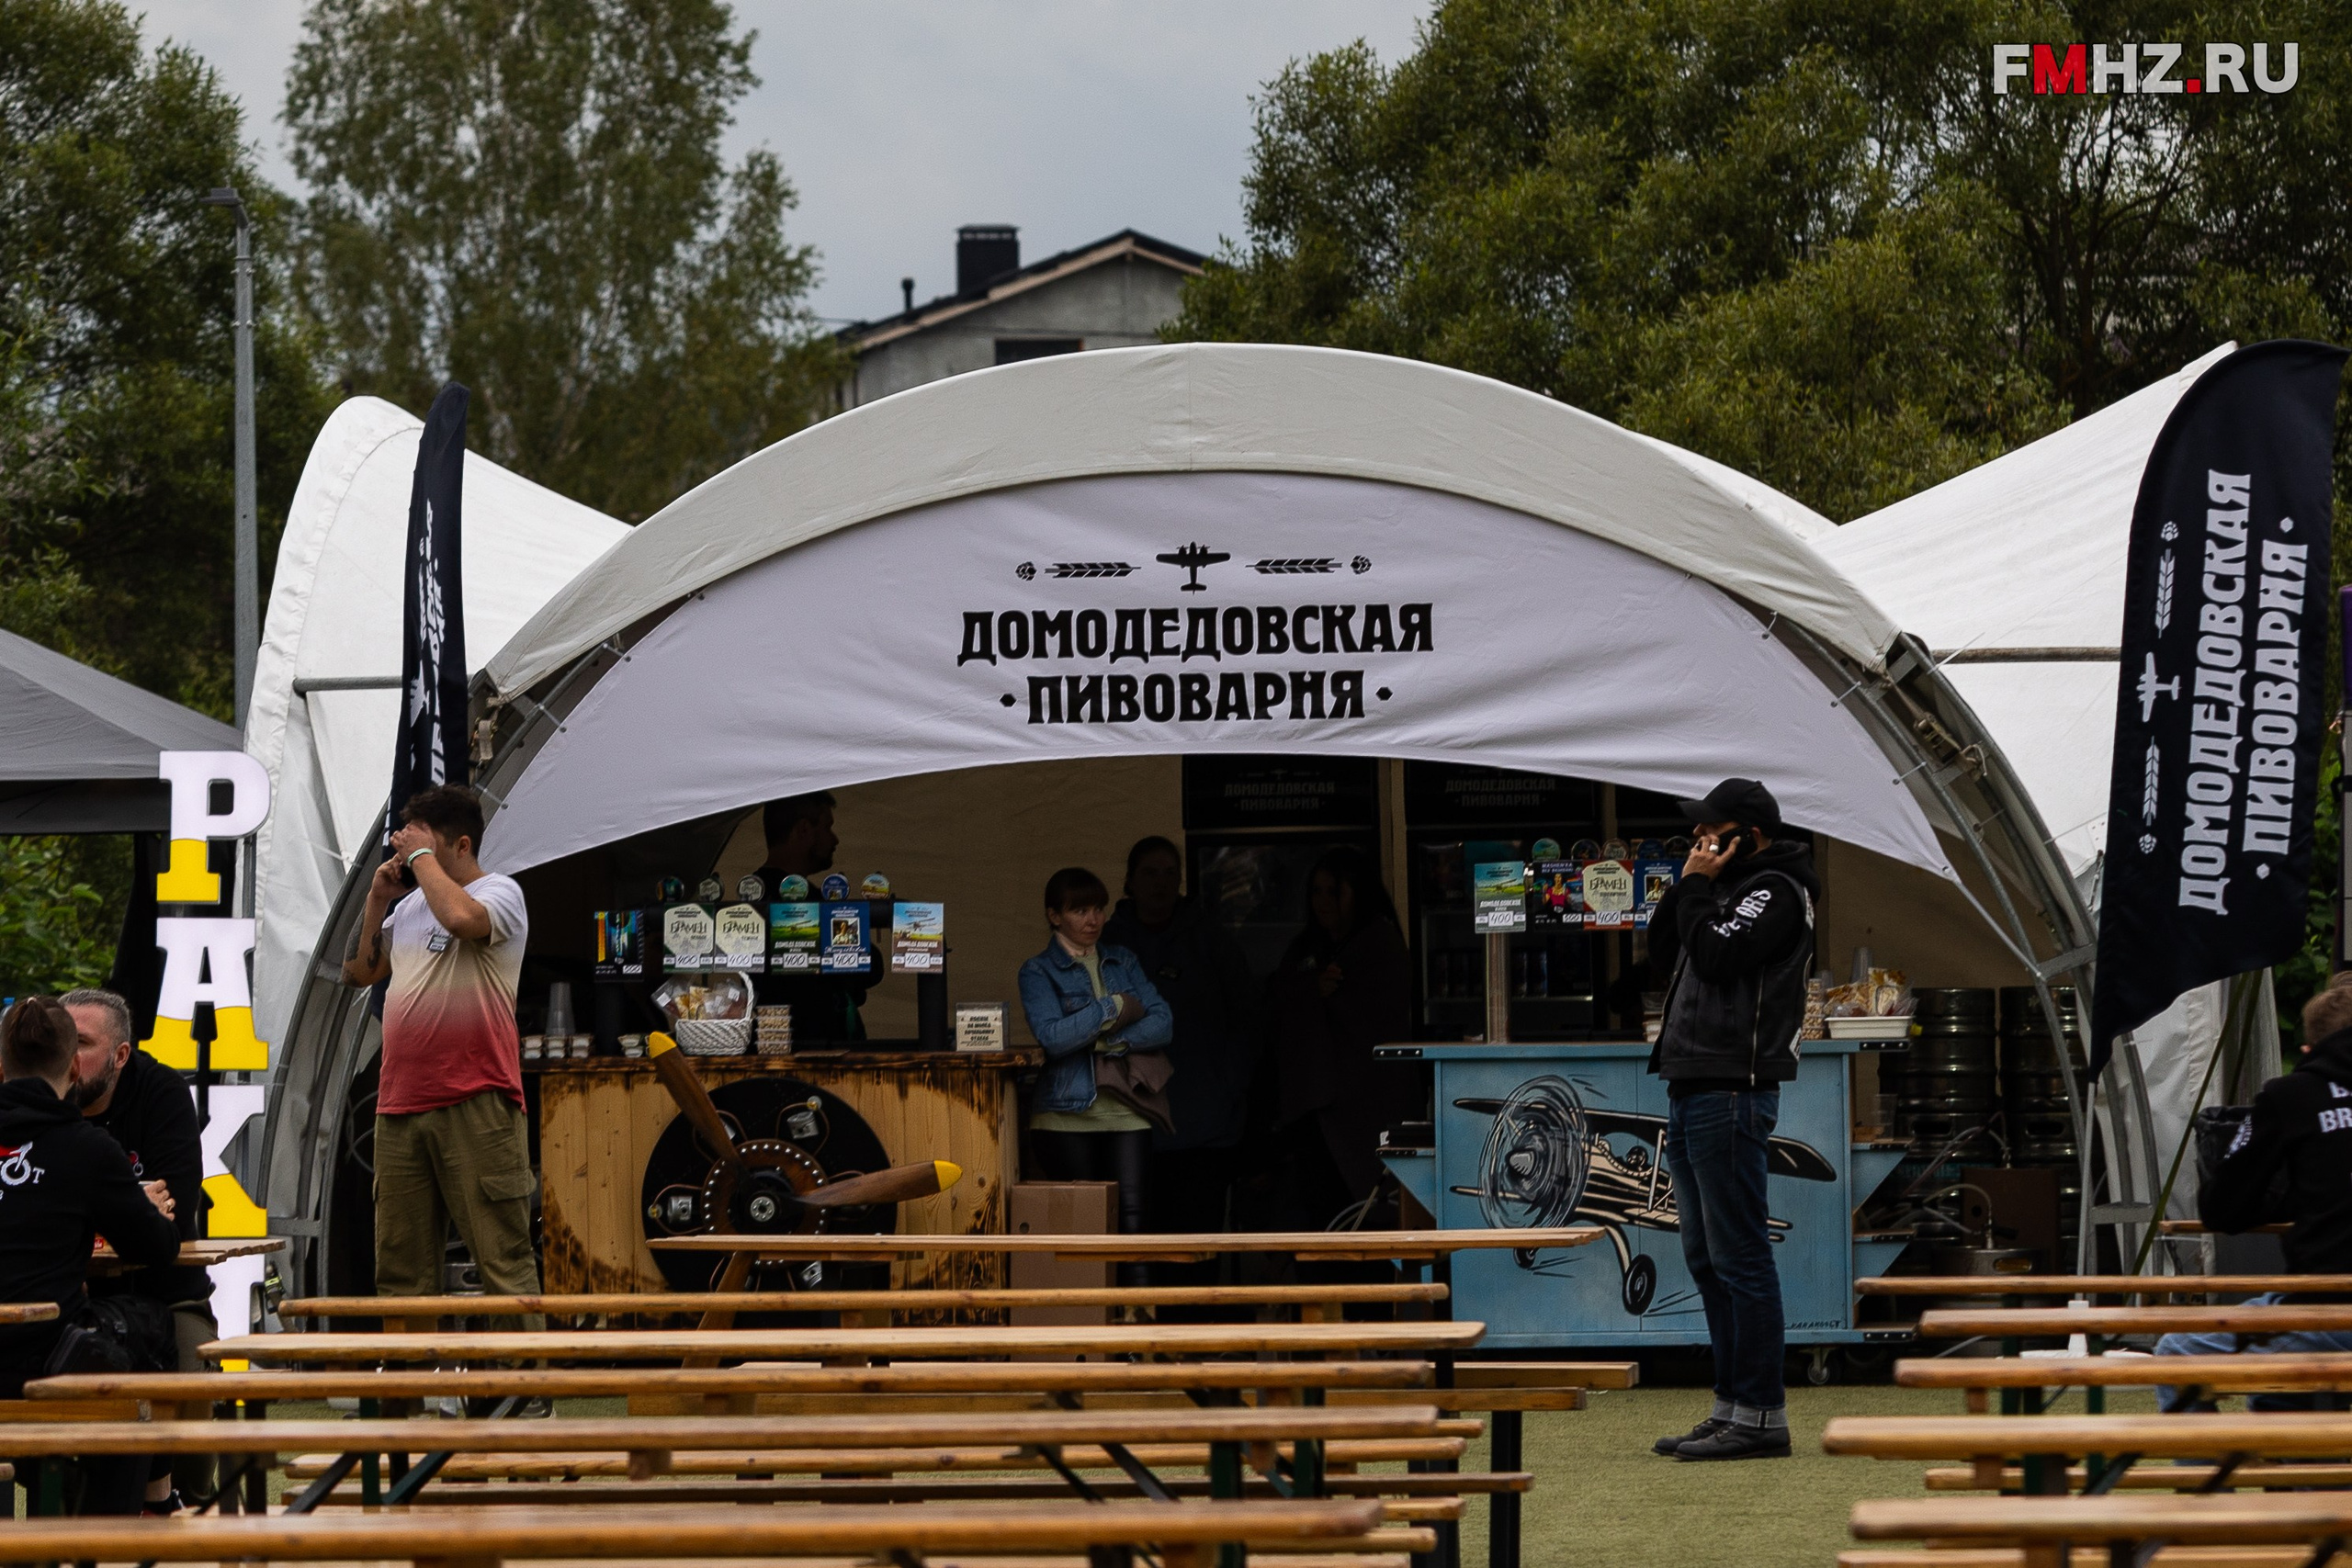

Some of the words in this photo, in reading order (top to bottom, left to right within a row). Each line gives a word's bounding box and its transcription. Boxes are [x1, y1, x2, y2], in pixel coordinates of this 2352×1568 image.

[957, 603, 1434, 667] ДОМОДЕДОВСКАЯ
[1027, 670, 1365, 724] ПИВОВАРНЯ
[2178, 469, 2251, 916] ДОМОДЕДОВСКАЯ
[2243, 538, 2308, 855] ПИВОВАРНЯ
[1224, 782, 1335, 796] ДОМОДЕДОВСКАЯ
[1445, 777, 1556, 793] ДОМОДЕДОВСКАЯ
[1239, 796, 1320, 811] ПИВОВАРНЯ
[1461, 793, 1541, 807] ПИВОВАРНЯ
[1490, 913, 1511, 925] 400
[1597, 912, 1620, 923] 400
[676, 954, 699, 965] 400
[729, 954, 751, 965] 400
[785, 954, 806, 965] 400
[835, 954, 856, 965] 400
[906, 954, 928, 965] 400
